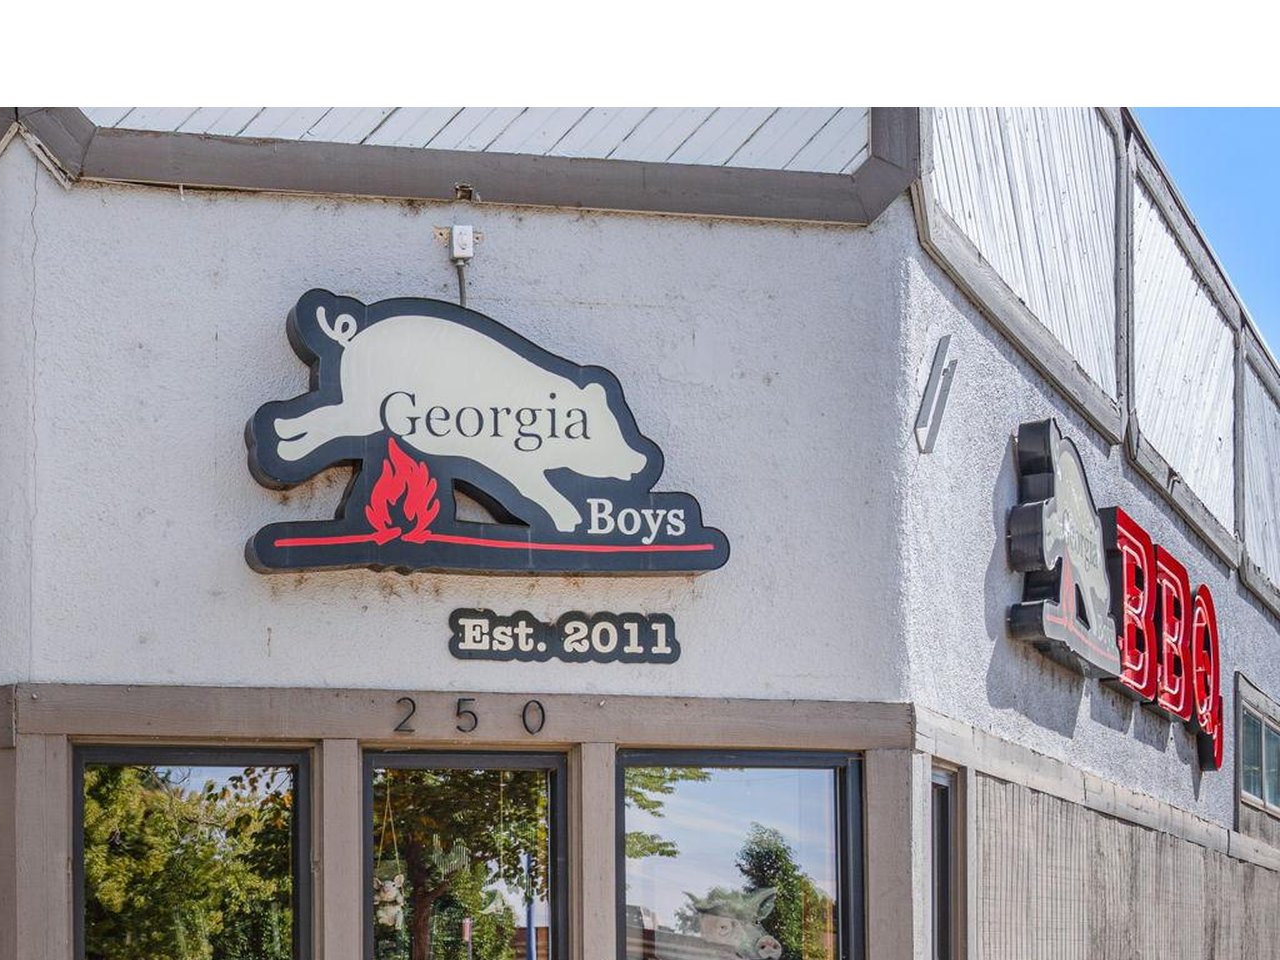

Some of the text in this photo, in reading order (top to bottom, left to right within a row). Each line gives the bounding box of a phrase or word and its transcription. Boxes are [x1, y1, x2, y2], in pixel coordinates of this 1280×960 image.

[380, 391, 591, 452] Georgia
[586, 498, 686, 545] Boys
[457, 617, 673, 656] Est. 2011
[1116, 505, 1223, 770] BBQ
